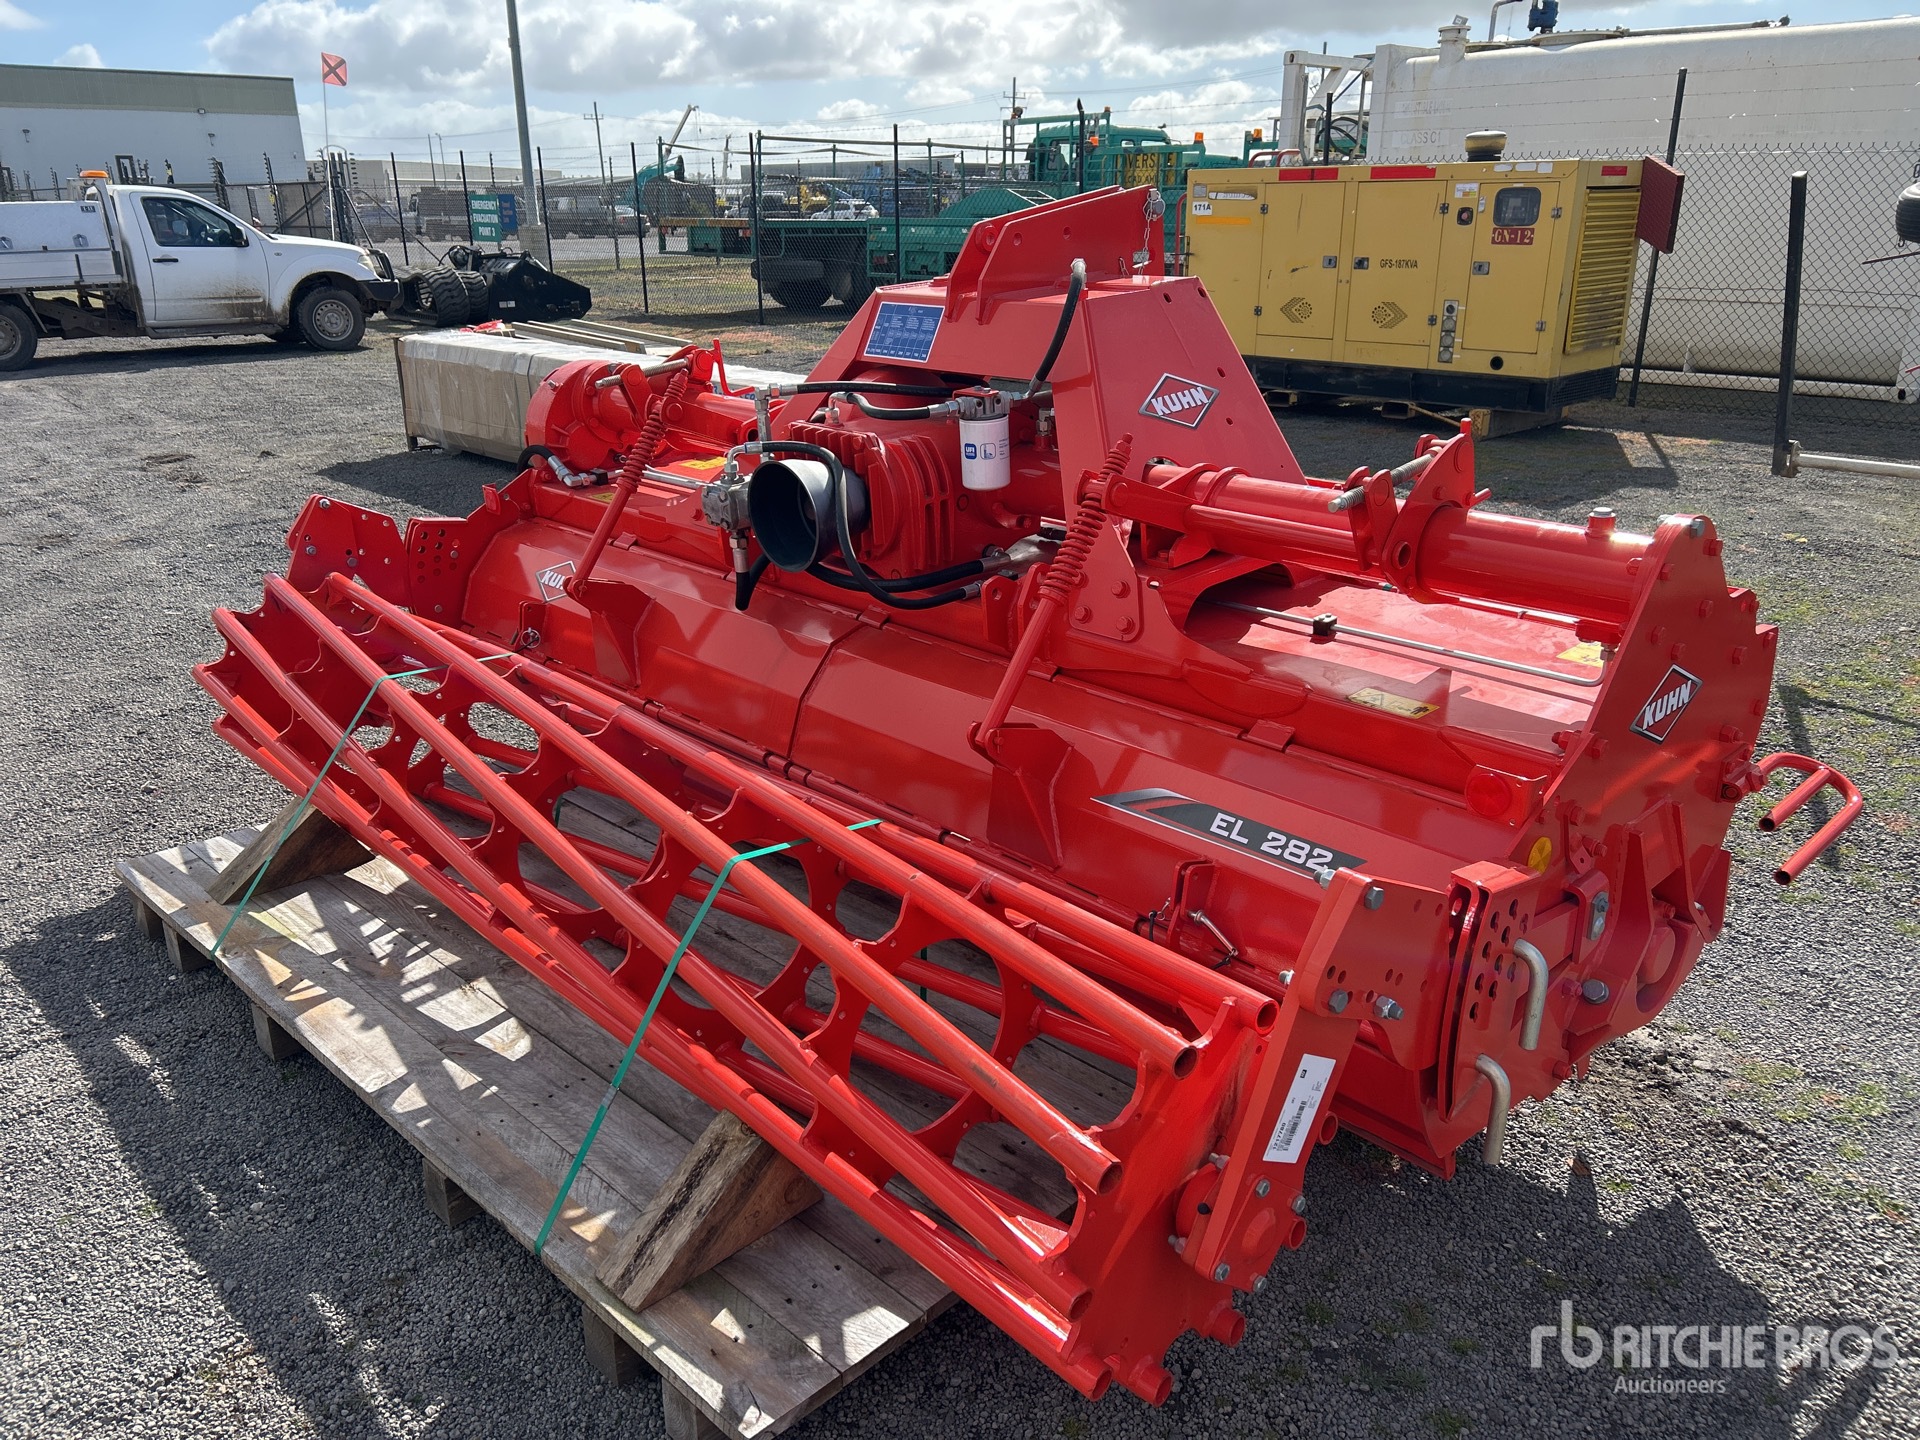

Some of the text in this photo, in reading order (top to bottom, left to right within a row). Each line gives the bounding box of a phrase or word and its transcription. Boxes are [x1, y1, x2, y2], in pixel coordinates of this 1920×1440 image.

[1118, 152, 1174, 169] VERSE
[471, 200, 497, 210] EMERGENCY
[1194, 203, 1211, 211] 171A
[473, 213, 499, 223] EVACUATION
[478, 226, 496, 237] POINT 3
[1380, 258, 1418, 269] GFS-187KVA
[1150, 386, 1209, 416] KUHN
[1642, 679, 1692, 731] KUHN
[1209, 812, 1334, 873] EL 282
